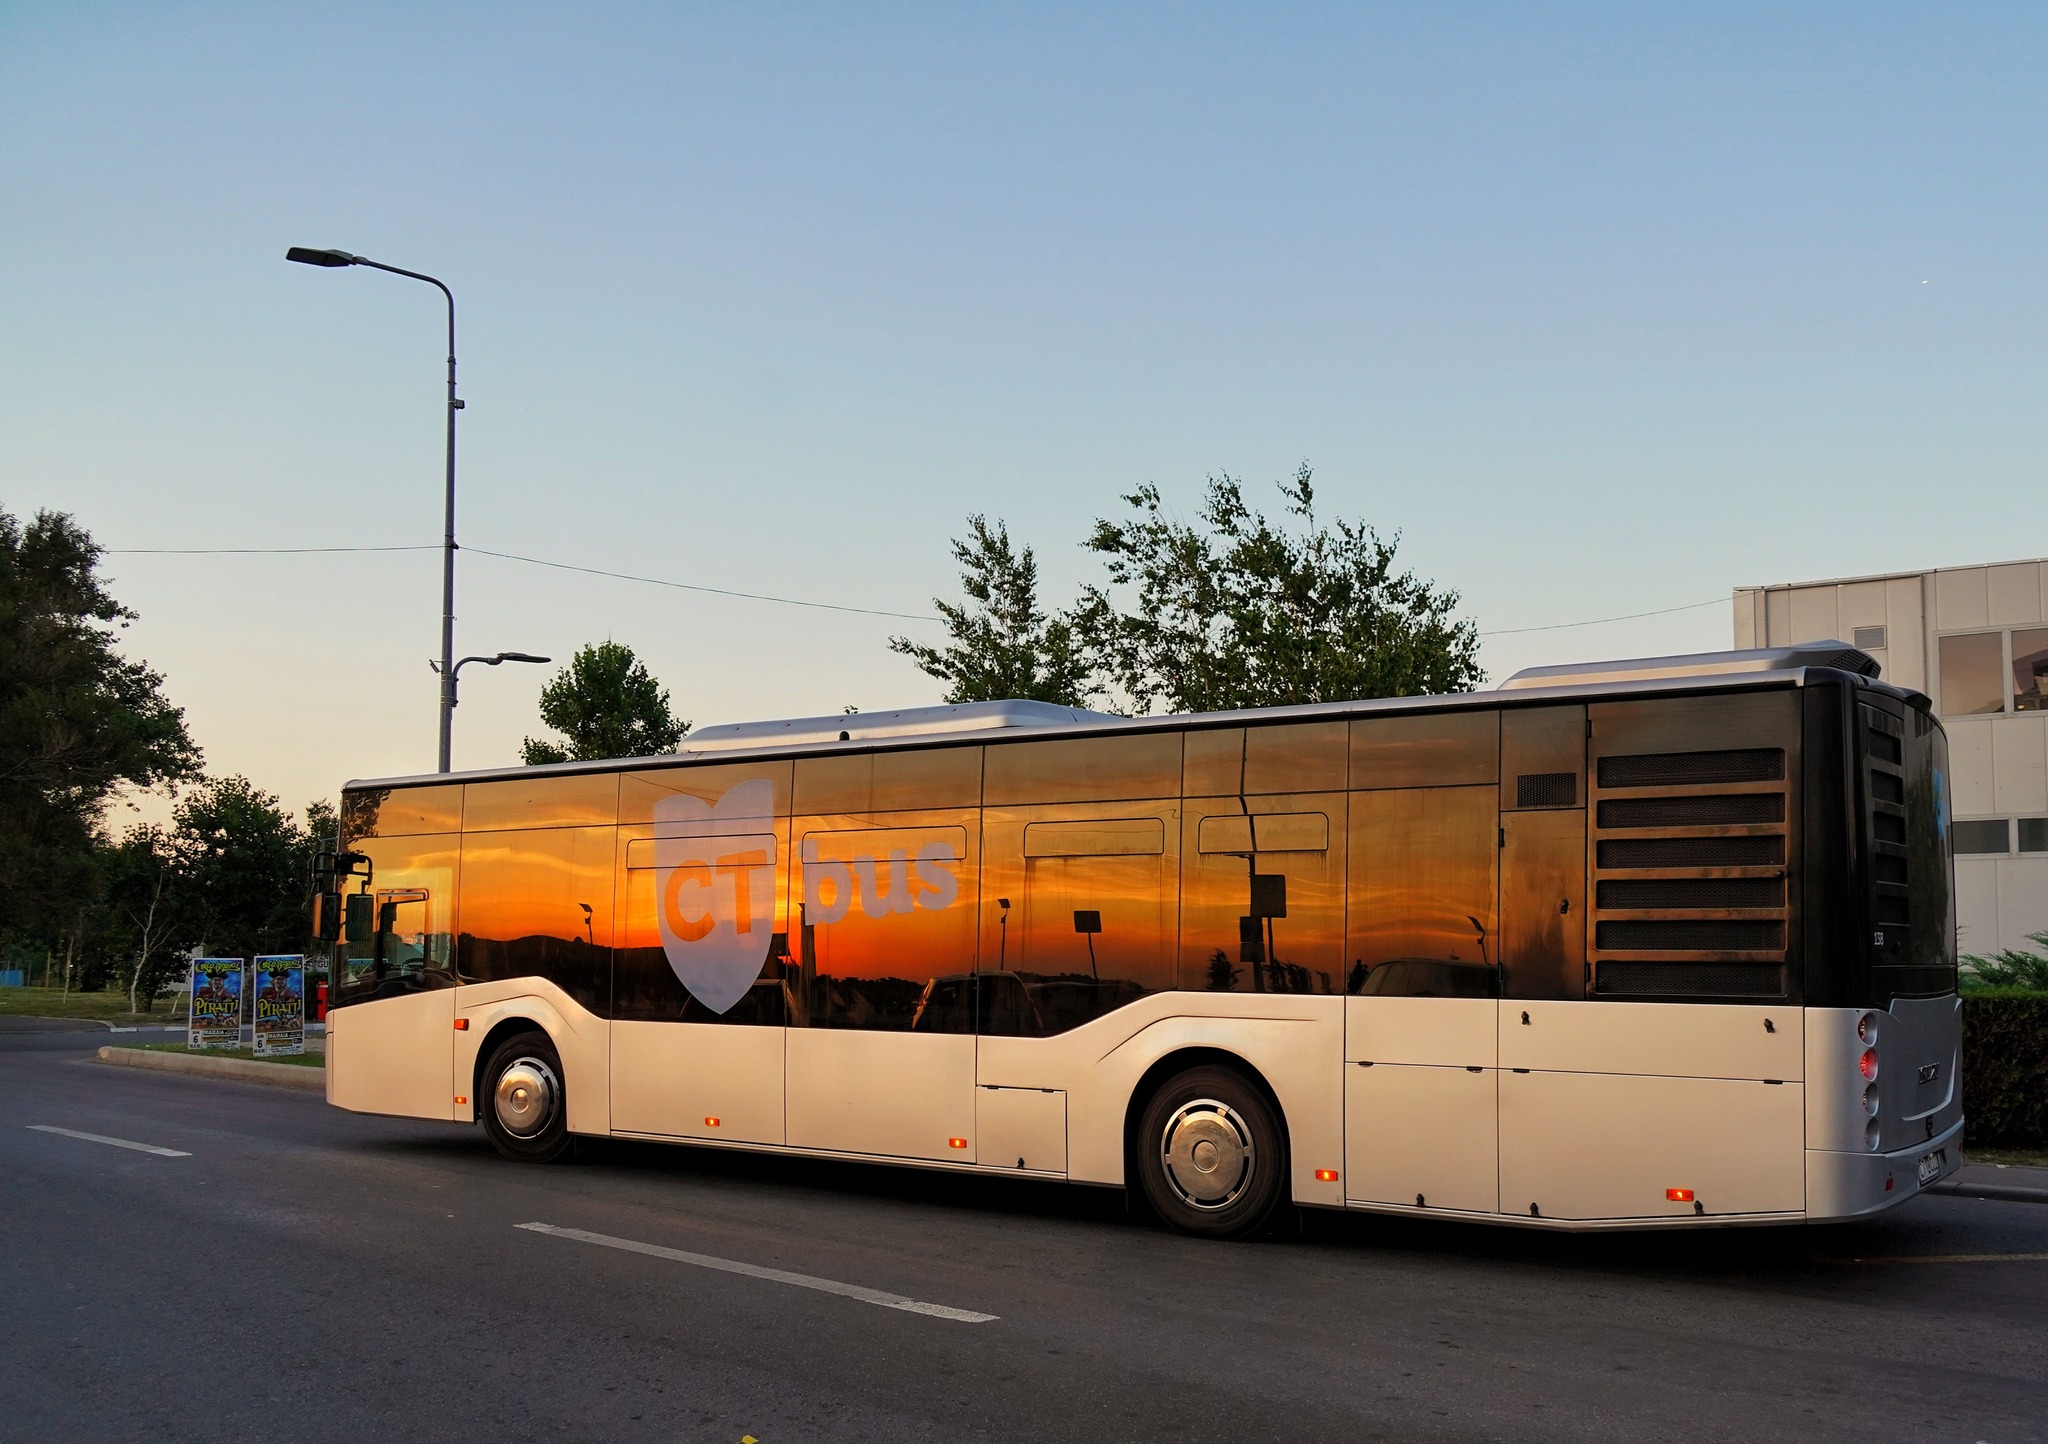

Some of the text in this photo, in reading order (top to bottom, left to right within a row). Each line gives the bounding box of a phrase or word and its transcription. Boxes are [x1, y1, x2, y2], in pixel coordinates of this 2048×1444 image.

[664, 839, 959, 942] CT bus
[1874, 931, 1885, 946] 138
[193, 1035, 199, 1044] 6
[257, 1039, 263, 1049] 6
